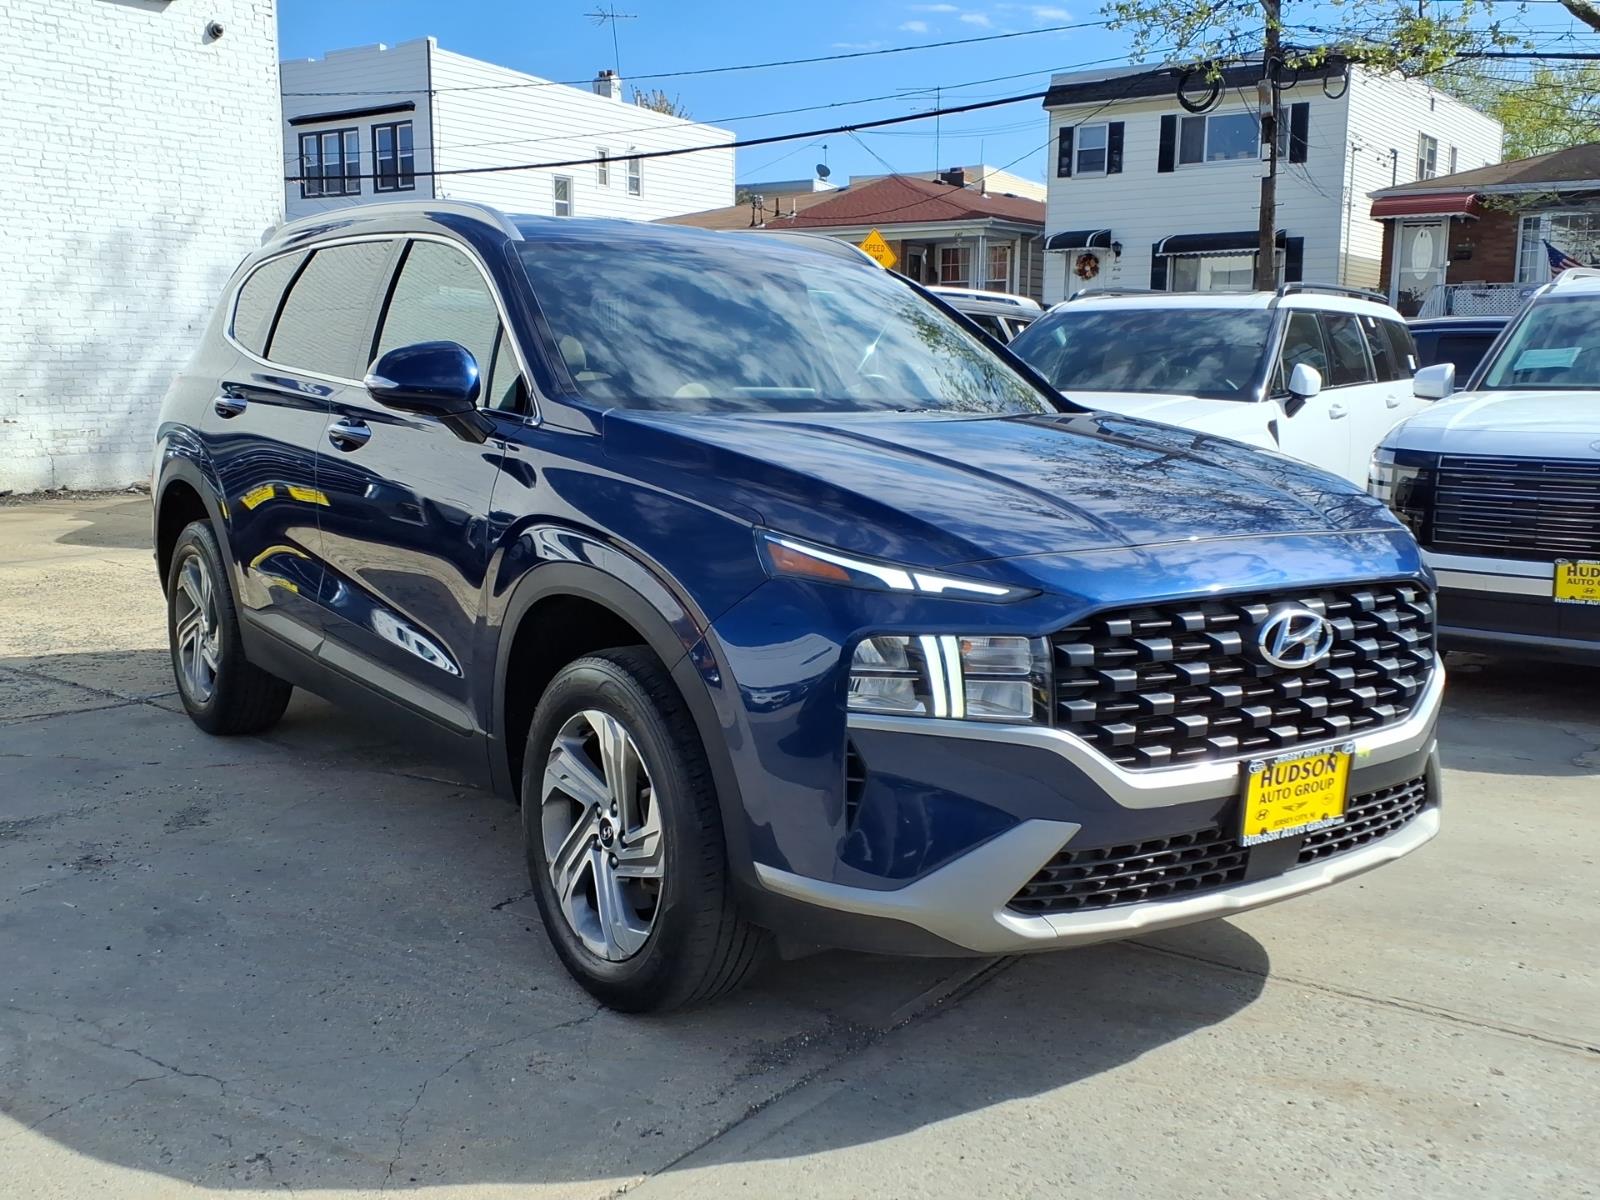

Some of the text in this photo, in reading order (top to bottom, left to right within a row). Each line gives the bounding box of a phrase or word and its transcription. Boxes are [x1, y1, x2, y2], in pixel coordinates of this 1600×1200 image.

[864, 243, 885, 252] SPEED
[1260, 755, 1338, 789] HUDSON
[1259, 777, 1335, 806] AUTO GROUP
[1243, 830, 1281, 847] HUDSON
[1281, 824, 1305, 838] AUTO
